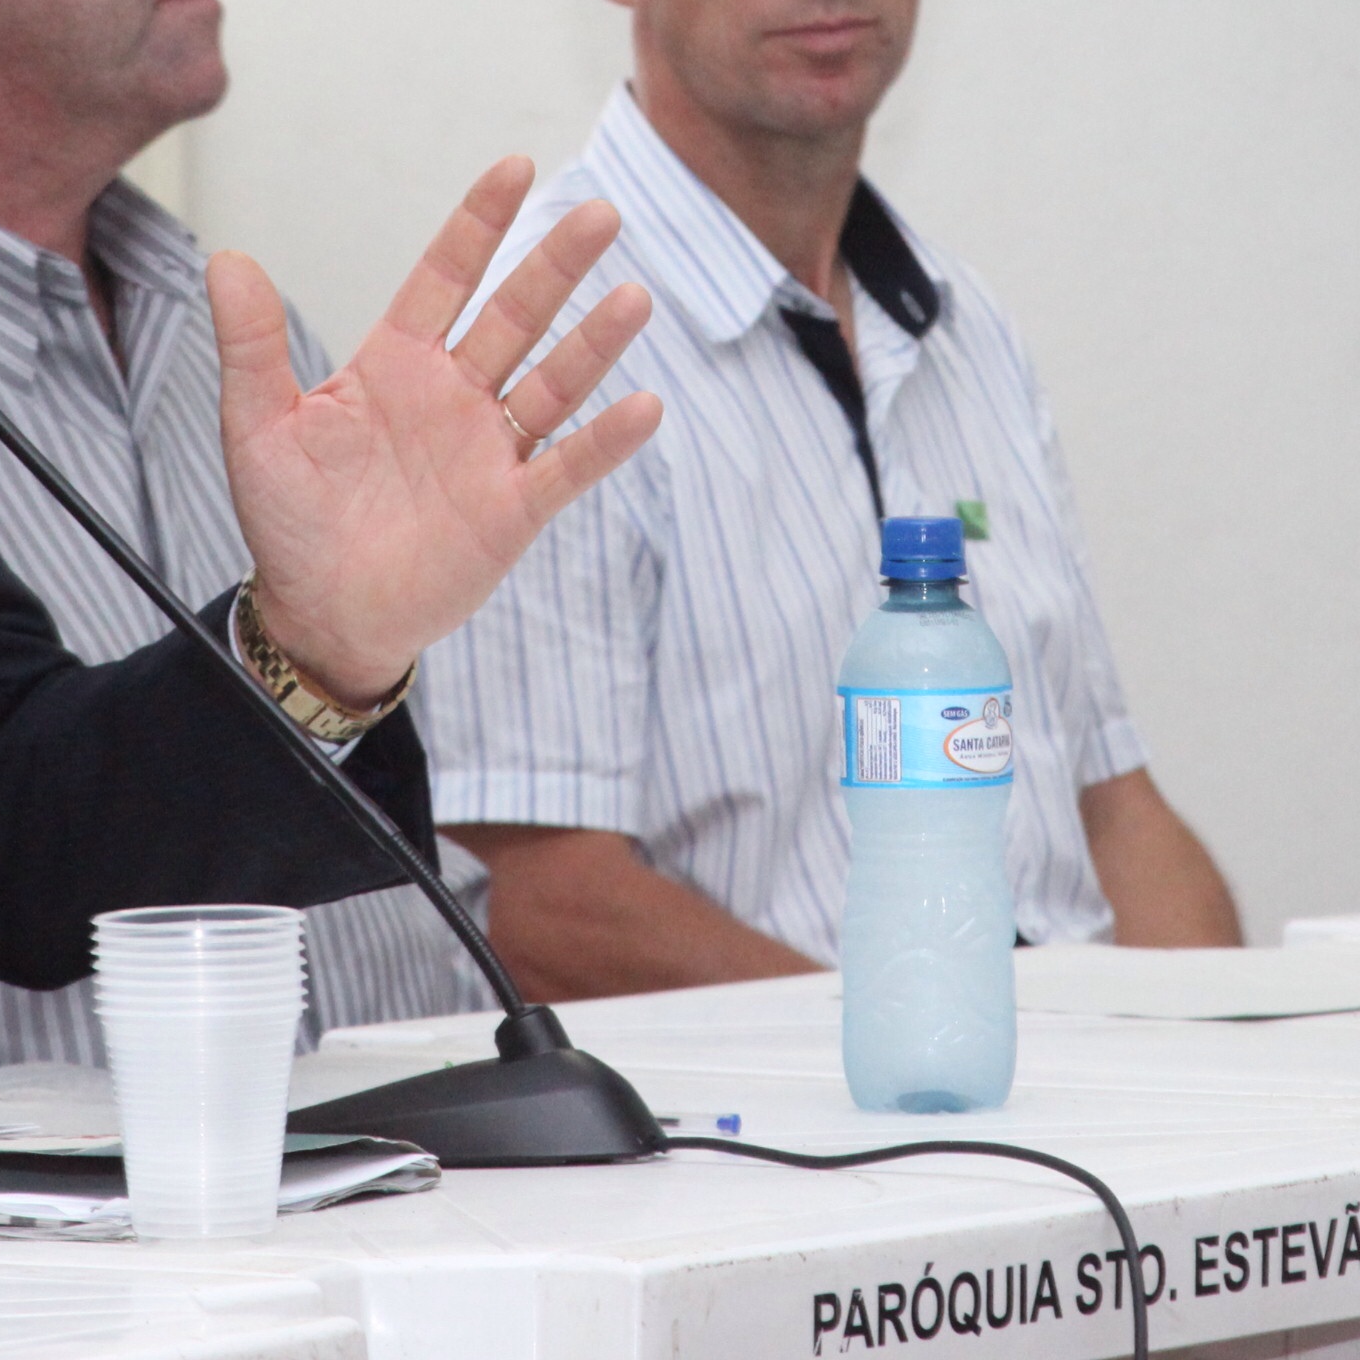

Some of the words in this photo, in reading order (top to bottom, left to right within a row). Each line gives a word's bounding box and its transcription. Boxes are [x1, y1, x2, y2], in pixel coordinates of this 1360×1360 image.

[953, 738, 984, 752] SANTA
[812, 1261, 1063, 1357] PARÓQUIA
[1074, 1244, 1178, 1316] STO.
